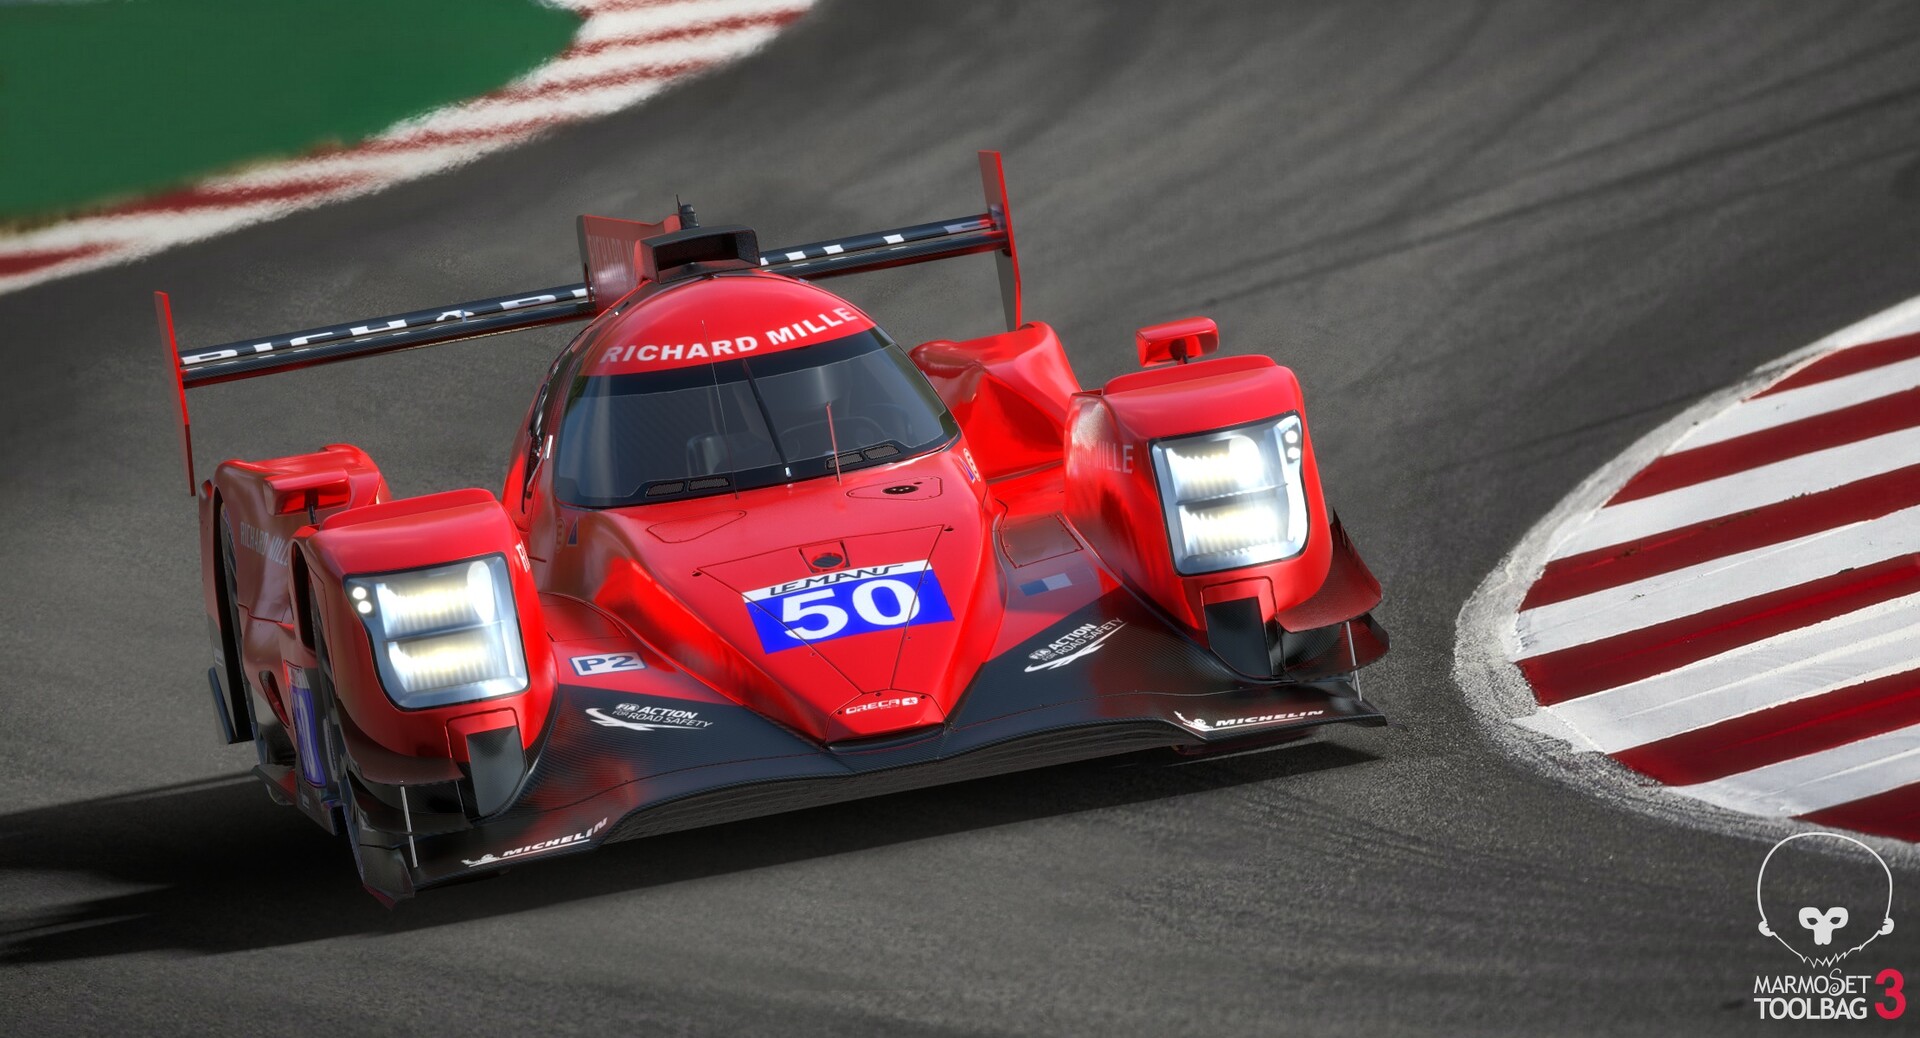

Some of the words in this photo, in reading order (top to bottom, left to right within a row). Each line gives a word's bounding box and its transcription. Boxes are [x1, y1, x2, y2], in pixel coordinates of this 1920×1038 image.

[599, 335, 758, 365] RICHARD
[765, 306, 859, 346] MILLE
[782, 579, 921, 641] 50
[1047, 623, 1098, 650] ACTION
[1057, 637, 1087, 655] ROAD
[1084, 617, 1123, 640] SAFETY
[577, 655, 638, 672] P2
[638, 705, 699, 719] ACTION
[845, 698, 900, 715] ORECA
[628, 711, 663, 723] ROAD
[663, 716, 714, 728] SAFETY
[1215, 709, 1324, 727] MICHELIN
[502, 817, 608, 857] MICHELIN
